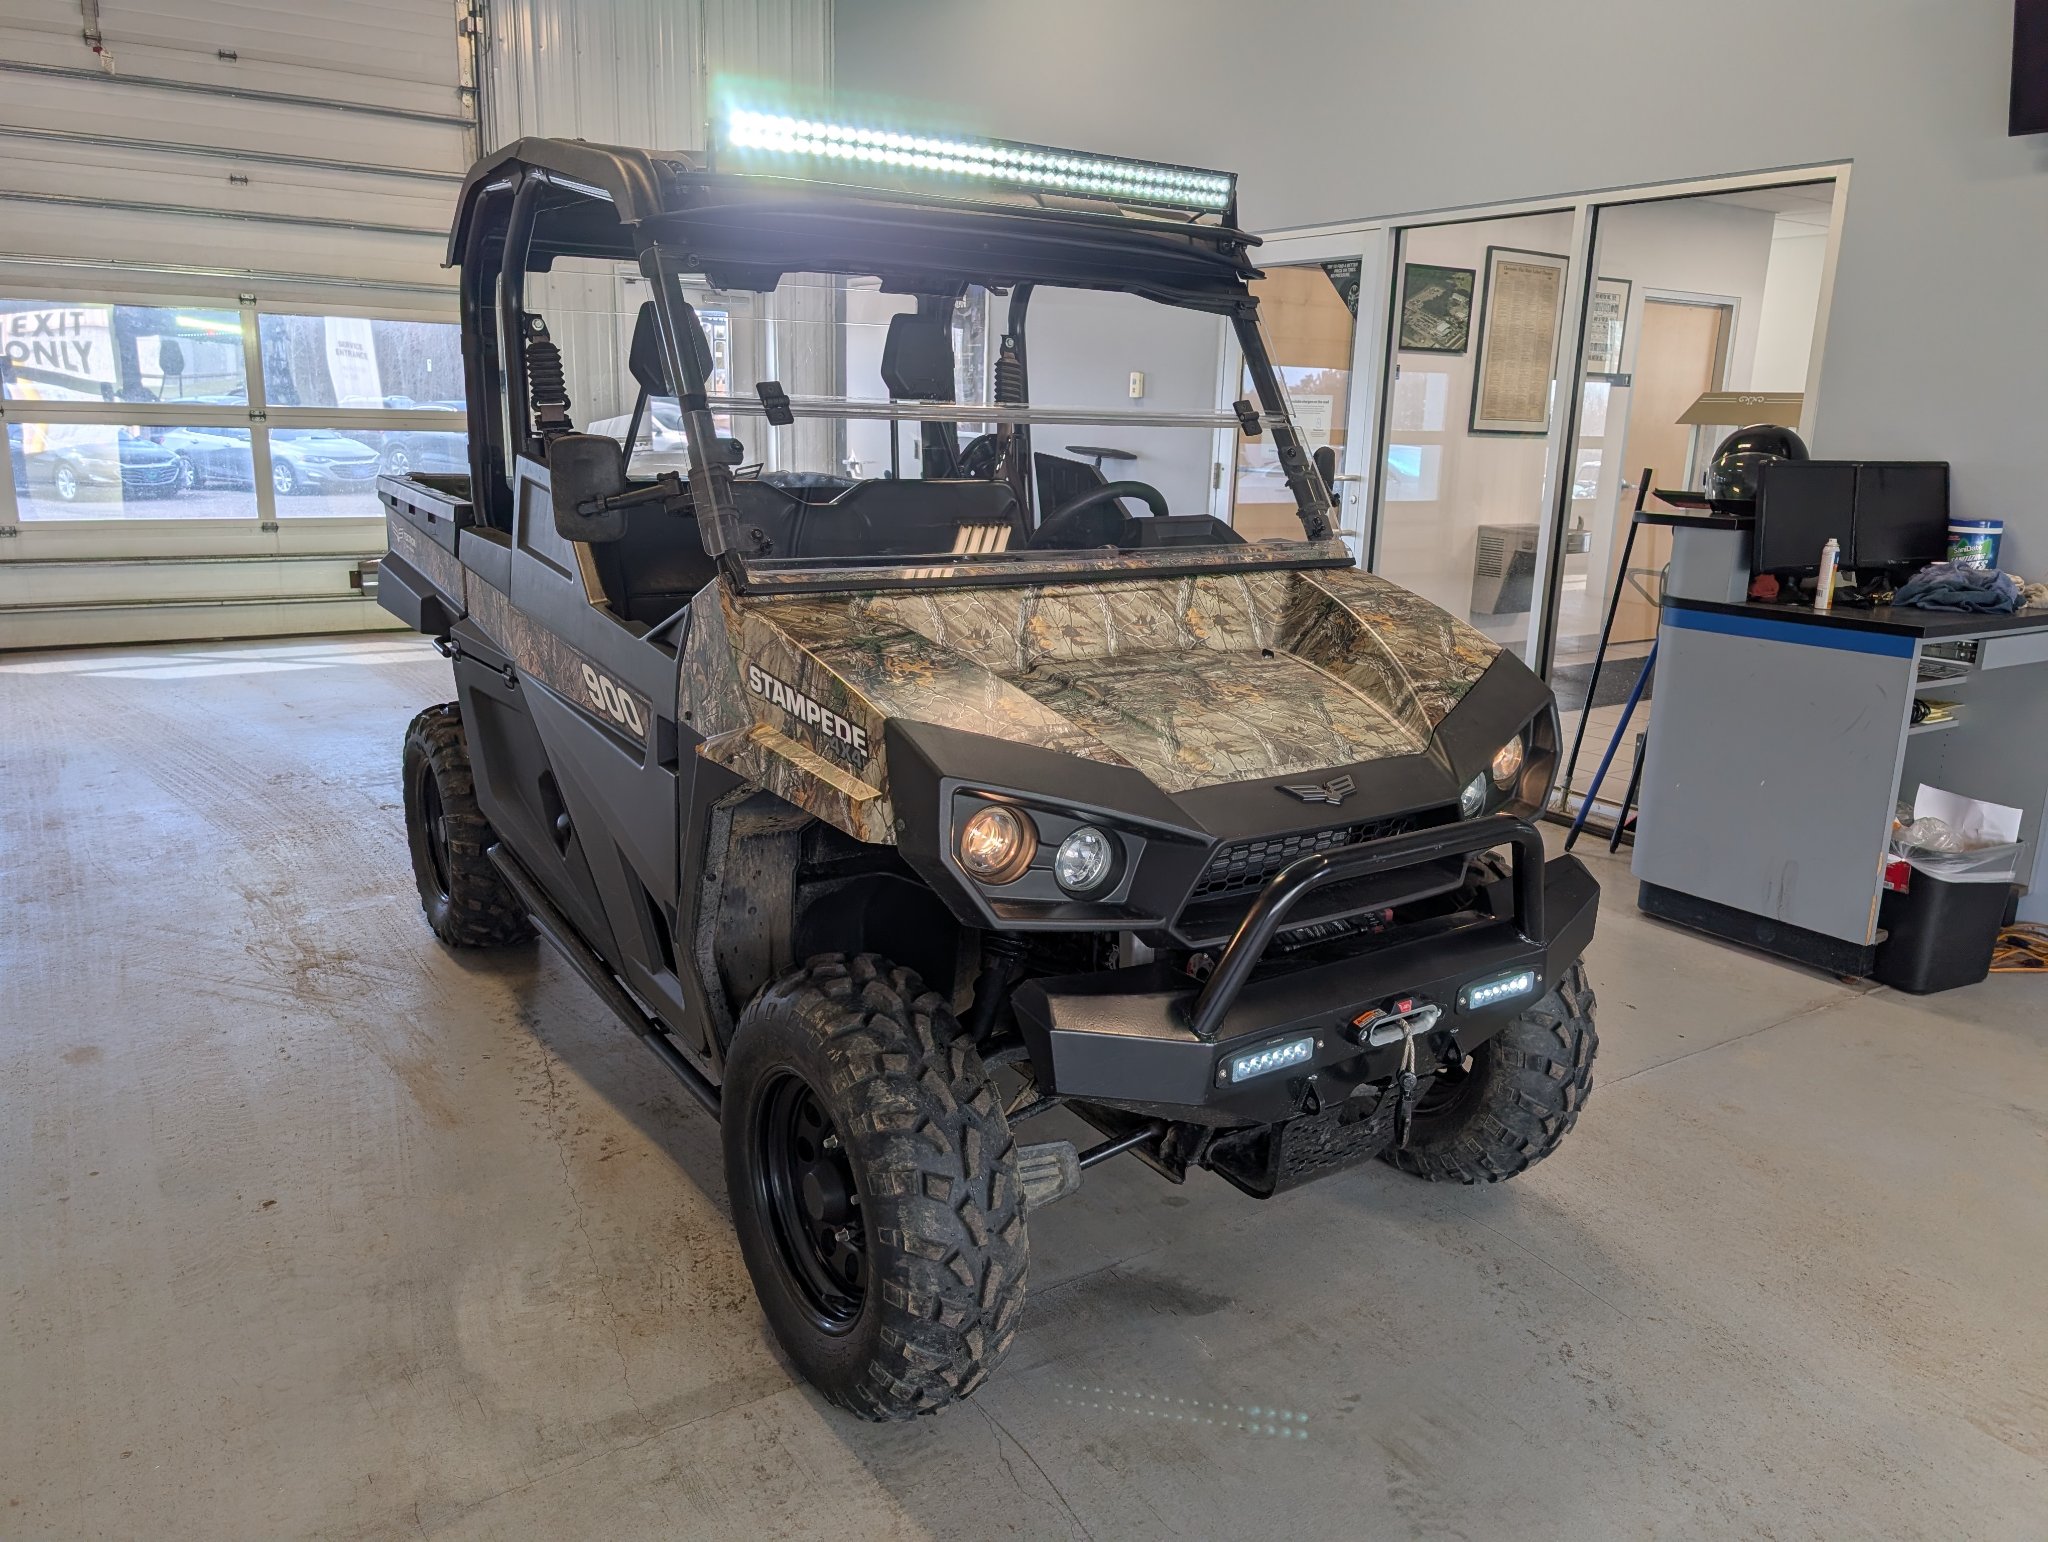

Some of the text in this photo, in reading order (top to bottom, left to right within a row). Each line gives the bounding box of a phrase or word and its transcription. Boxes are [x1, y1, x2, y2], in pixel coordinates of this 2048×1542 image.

[11, 311, 84, 337] EXIT
[5, 340, 93, 375] ONLY
[335, 348, 369, 361] ENTRANCE
[337, 340, 363, 351] SERVICE
[581, 663, 644, 737] 900
[749, 664, 868, 758] STAMPEDE
